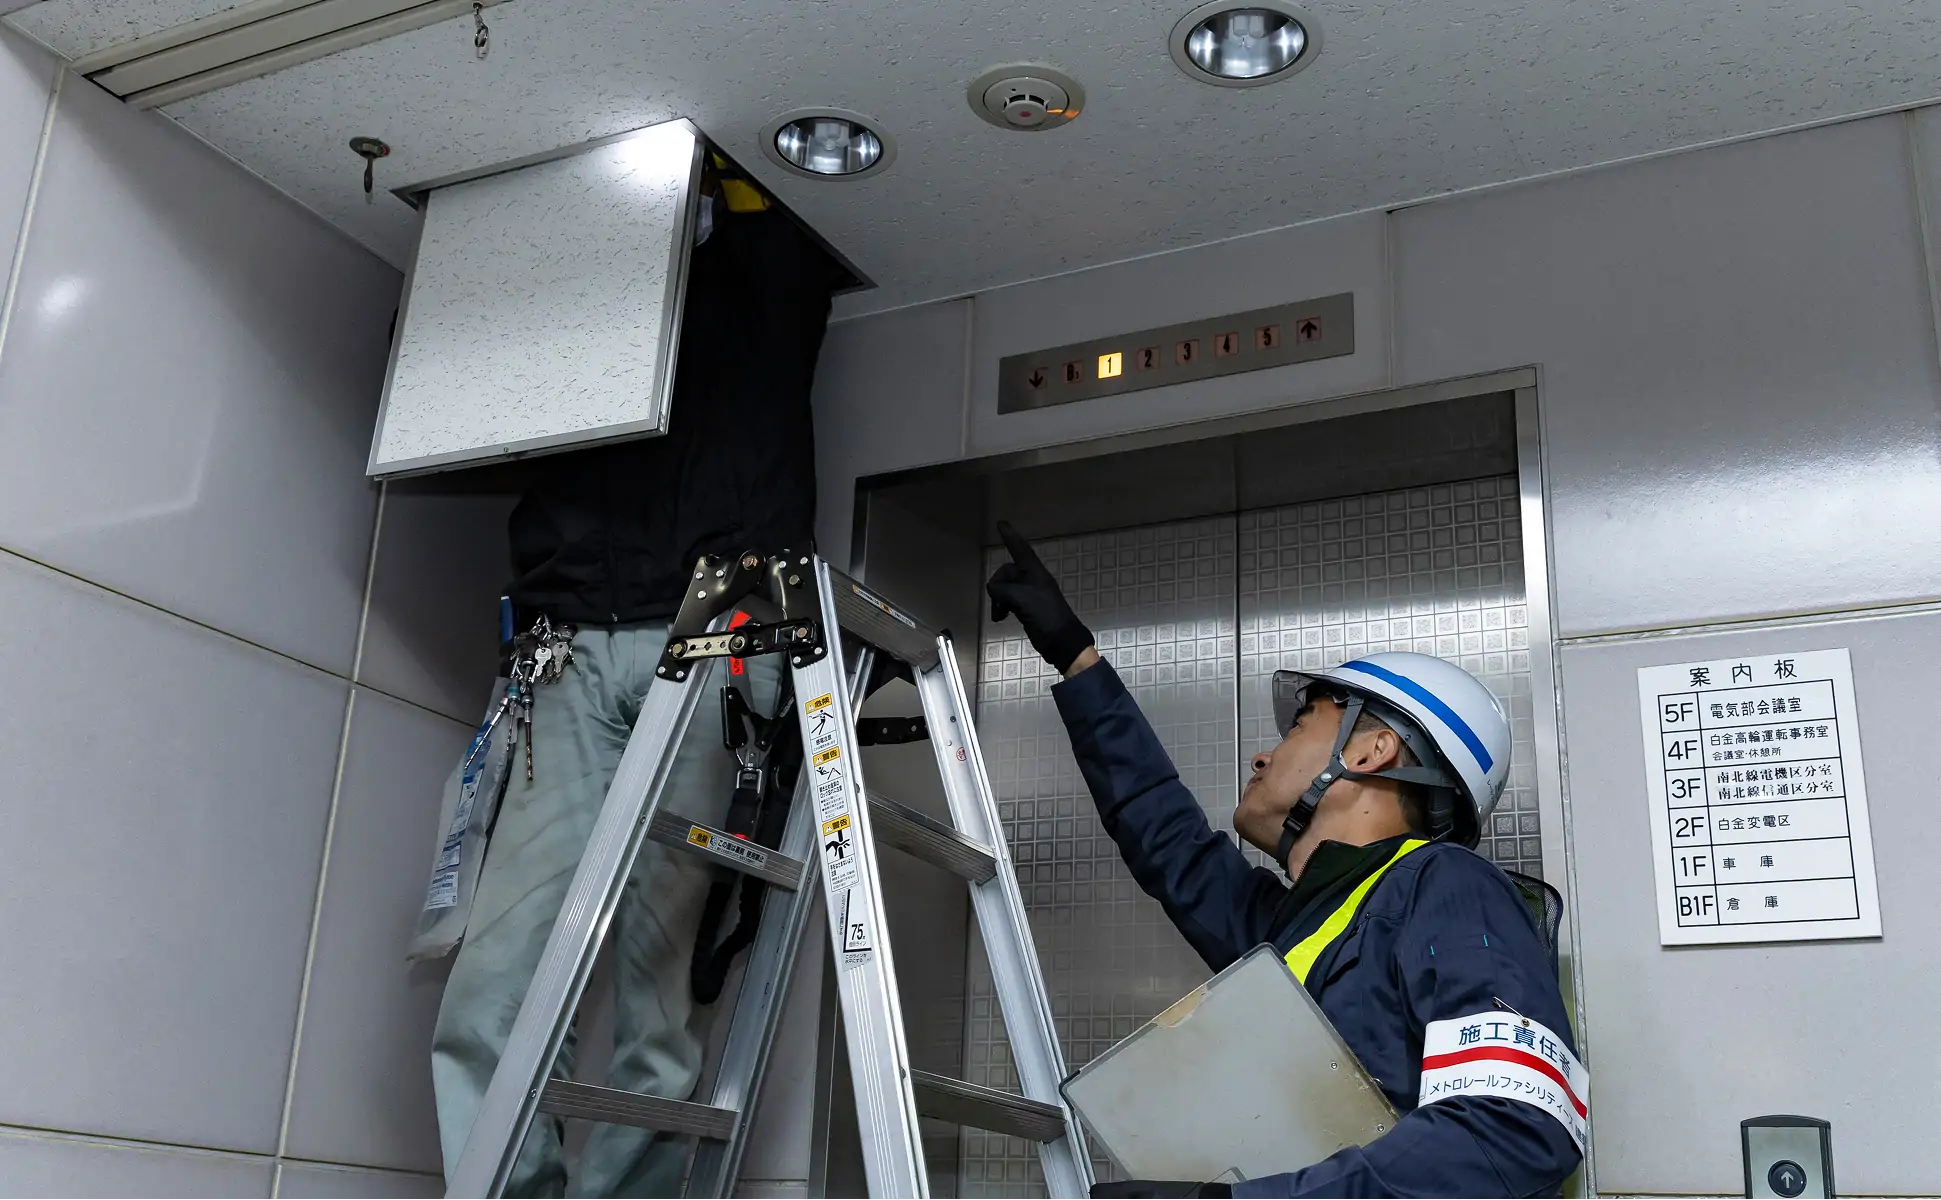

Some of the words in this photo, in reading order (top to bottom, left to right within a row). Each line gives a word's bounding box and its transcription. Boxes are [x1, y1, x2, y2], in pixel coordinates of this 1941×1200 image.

[1106, 356, 1113, 374] 1
[1144, 350, 1152, 368] 2
[1183, 343, 1191, 361] 3
[1222, 334, 1231, 353] 4
[1263, 328, 1271, 346] 5
[1665, 702, 1694, 723] 5F
[1710, 697, 1802, 719] 電気部会議室
[1710, 725, 1829, 747] 白金高輪運転事務室
[1667, 740, 1698, 761] 4F
[1717, 764, 1832, 784] 南北線電機区分室
[1671, 778, 1701, 799] 3F
[1718, 780, 1834, 800] 南北線信通区分室
[1675, 816, 1705, 838] 2F
[1718, 814, 1791, 831] 白金変電区
[1680, 855, 1707, 877] 1F
[1680, 895, 1714, 917] B1F
[1459, 1022, 1572, 1079] 施工責任者
